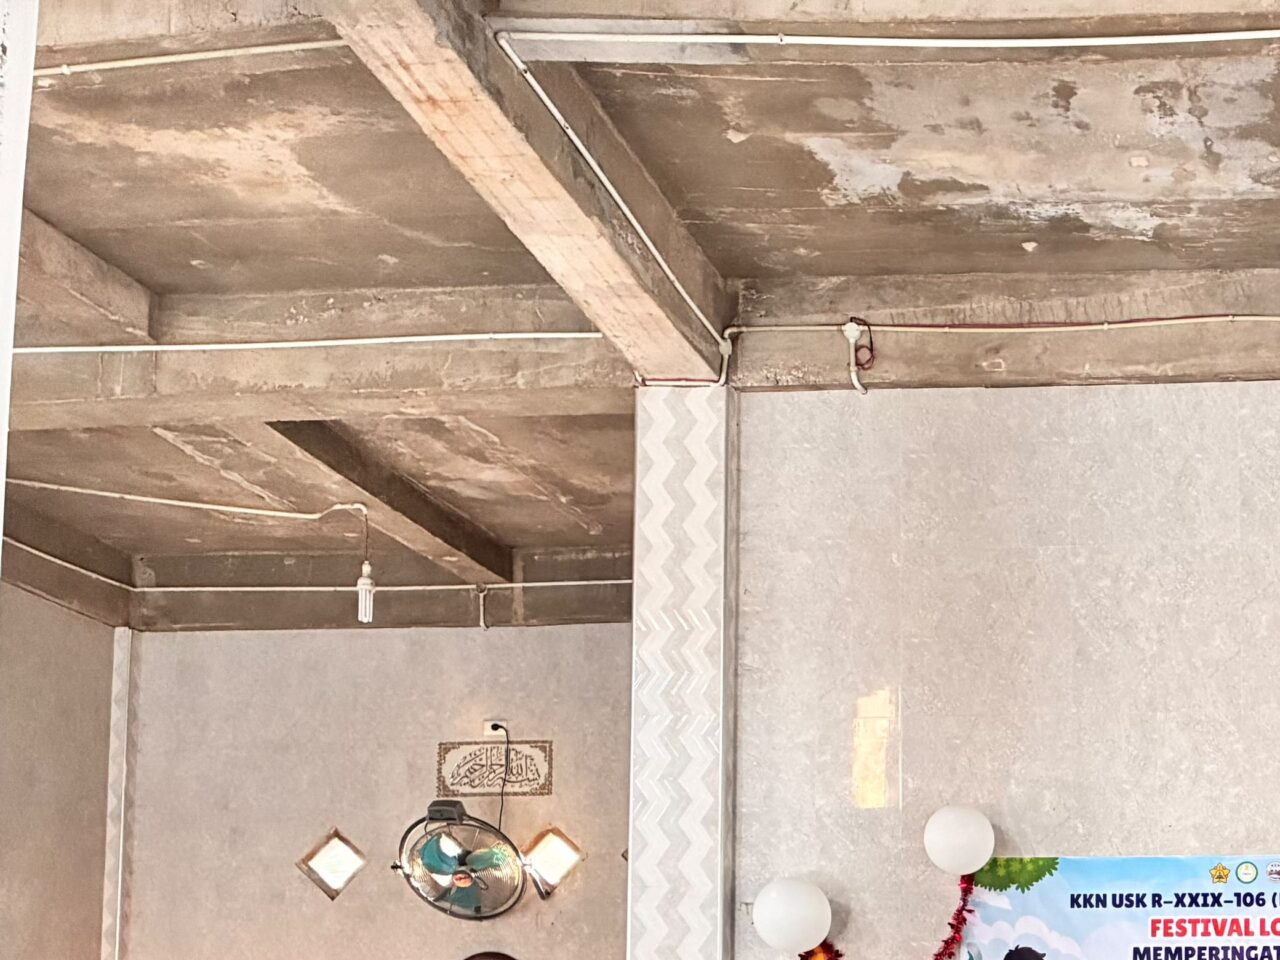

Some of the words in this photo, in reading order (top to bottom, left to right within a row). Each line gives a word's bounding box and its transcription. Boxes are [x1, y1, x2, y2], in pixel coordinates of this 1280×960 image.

[1069, 893, 1108, 909] KKN
[1111, 893, 1148, 909] USK
[1150, 917, 1255, 938] FESTIVAL
